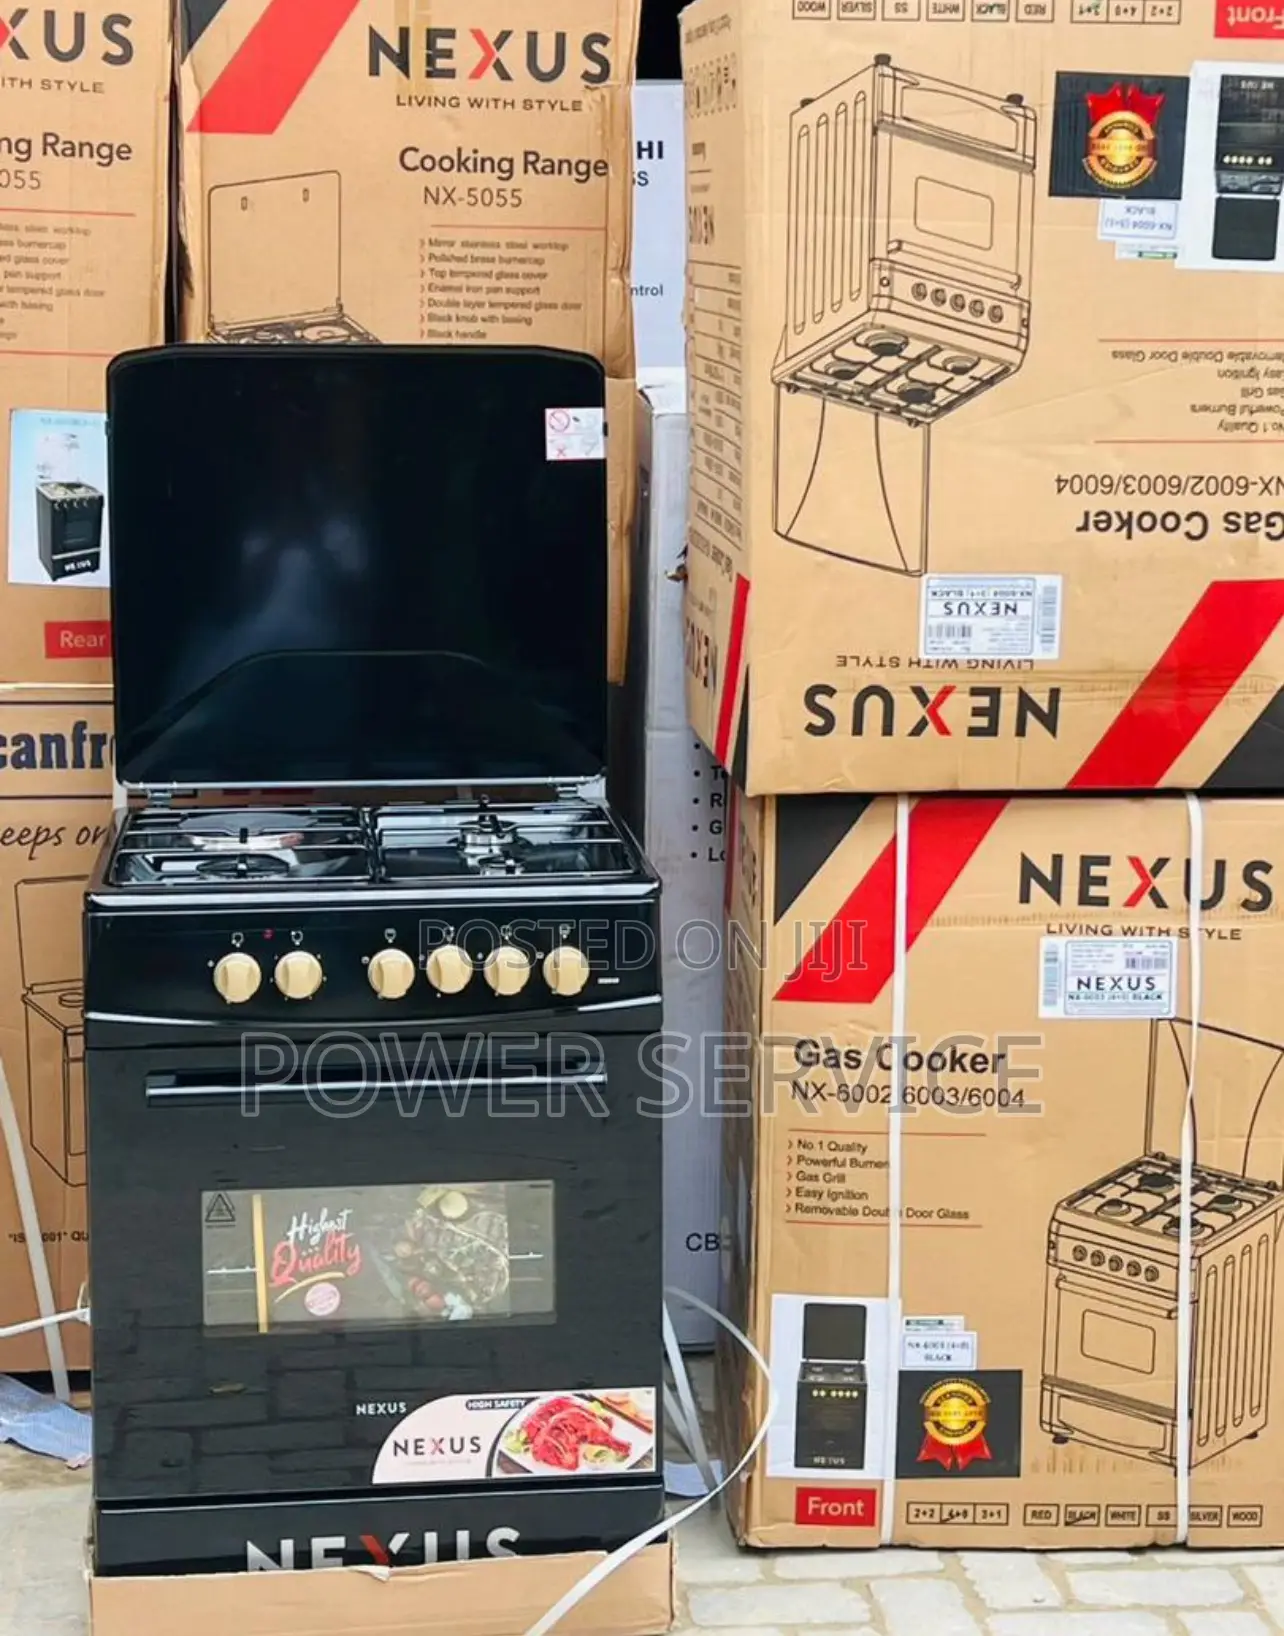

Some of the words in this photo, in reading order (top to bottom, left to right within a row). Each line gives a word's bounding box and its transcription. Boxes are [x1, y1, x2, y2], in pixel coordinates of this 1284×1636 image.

[797, 2, 826, 12] WOOD
[932, 2, 960, 14] WHITE
[1025, 3, 1046, 15] RED
[368, 24, 612, 85] NEXUS
[40, 79, 105, 94] STYLE
[396, 94, 461, 109] LIVING
[467, 98, 516, 110] WITH
[522, 99, 583, 112] STYLE
[42, 132, 133, 168] Range
[399, 146, 514, 181] Cooking
[523, 150, 609, 184] Range
[423, 185, 523, 208] NX-5055
[1111, 350, 1145, 363] Glass
[1149, 350, 1178, 363] Door
[1181, 350, 1224, 363] Double
[1217, 366, 1260, 382] Ignition
[1240, 387, 1264, 399] Grill
[1190, 403, 1237, 416] Burners
[1217, 419, 1259, 434] Quality
[1075, 509, 1209, 541] Cooker
[1222, 510, 1284, 542] Gas
[943, 601, 1018, 617] NEXUS
[59, 629, 107, 649] Rear
[835, 654, 901, 668] STYLE
[907, 656, 959, 669] WITH
[966, 658, 1035, 670] LIVING
[803, 684, 1062, 741] NEXUS
[1018, 851, 1273, 912] NEXUS
[1045, 922, 1114, 937] LIVING
[1121, 924, 1172, 938] WITH
[1077, 975, 1156, 991] NEXUS
[793, 1038, 862, 1071] Gas
[791, 1080, 1025, 1108] NX-60026003/6004
[827, 1140, 868, 1156] Quality
[796, 1155, 847, 1169] Powerful
[796, 1170, 820, 1183] Gas
[823, 1171, 846, 1185] Grill
[795, 1186, 825, 1202] Easy
[827, 1187, 869, 1202] Ignition
[795, 1203, 860, 1217] Removable
[906, 1206, 935, 1219] Door
[937, 1208, 970, 1220] Glass
[268, 1231, 363, 1288] Quality
[356, 1401, 407, 1416] NEXUS
[467, 1399, 493, 1411] HIGH
[494, 1398, 527, 1410] SAFETY
[393, 1436, 482, 1458] NEXUS
[807, 1495, 865, 1517] Front
[913, 1507, 935, 1519] 2+2
[1030, 1509, 1052, 1521] RED
[1110, 1510, 1137, 1522] WHITE
[1156, 1510, 1170, 1521] SS
[1231, 1511, 1258, 1522] WOOD
